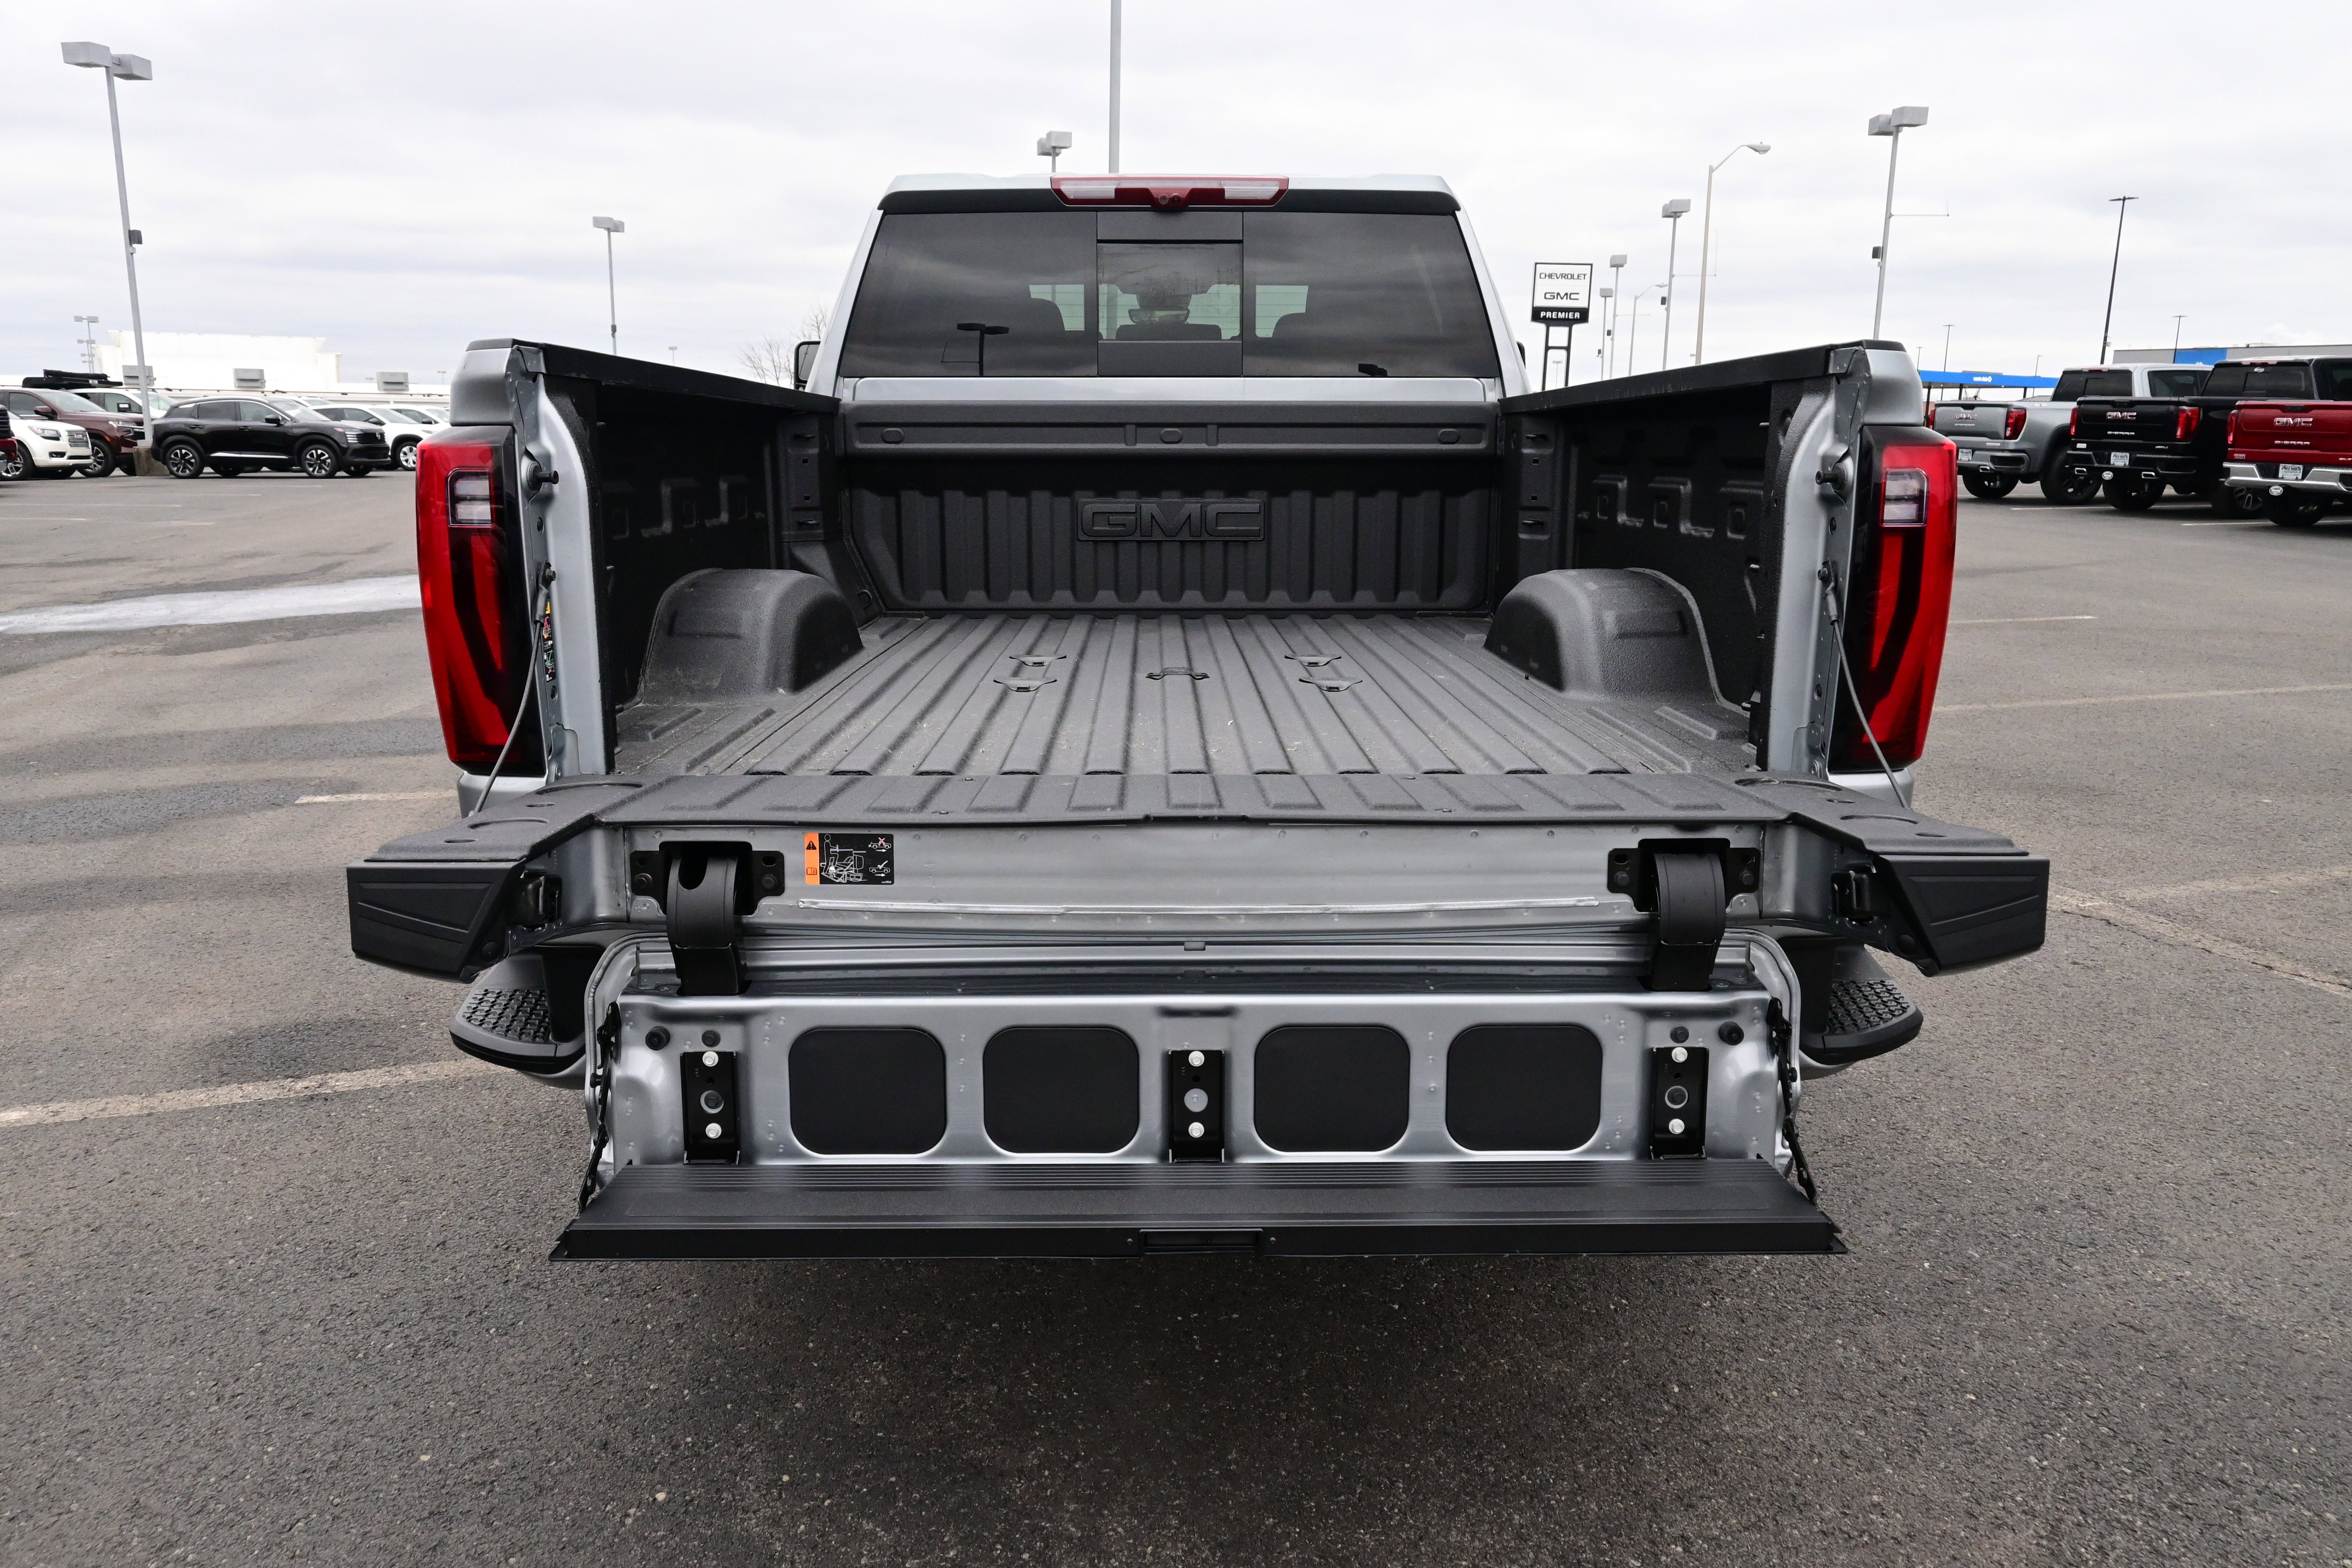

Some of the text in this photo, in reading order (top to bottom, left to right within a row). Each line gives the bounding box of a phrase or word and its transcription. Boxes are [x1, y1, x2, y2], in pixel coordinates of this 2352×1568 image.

[1544, 292, 1580, 300] GMC
[1540, 311, 1580, 319] PREMIER
[2106, 411, 2137, 420] GMC
[2273, 417, 2314, 427] GMC
[1081, 503, 1261, 537] GMC
